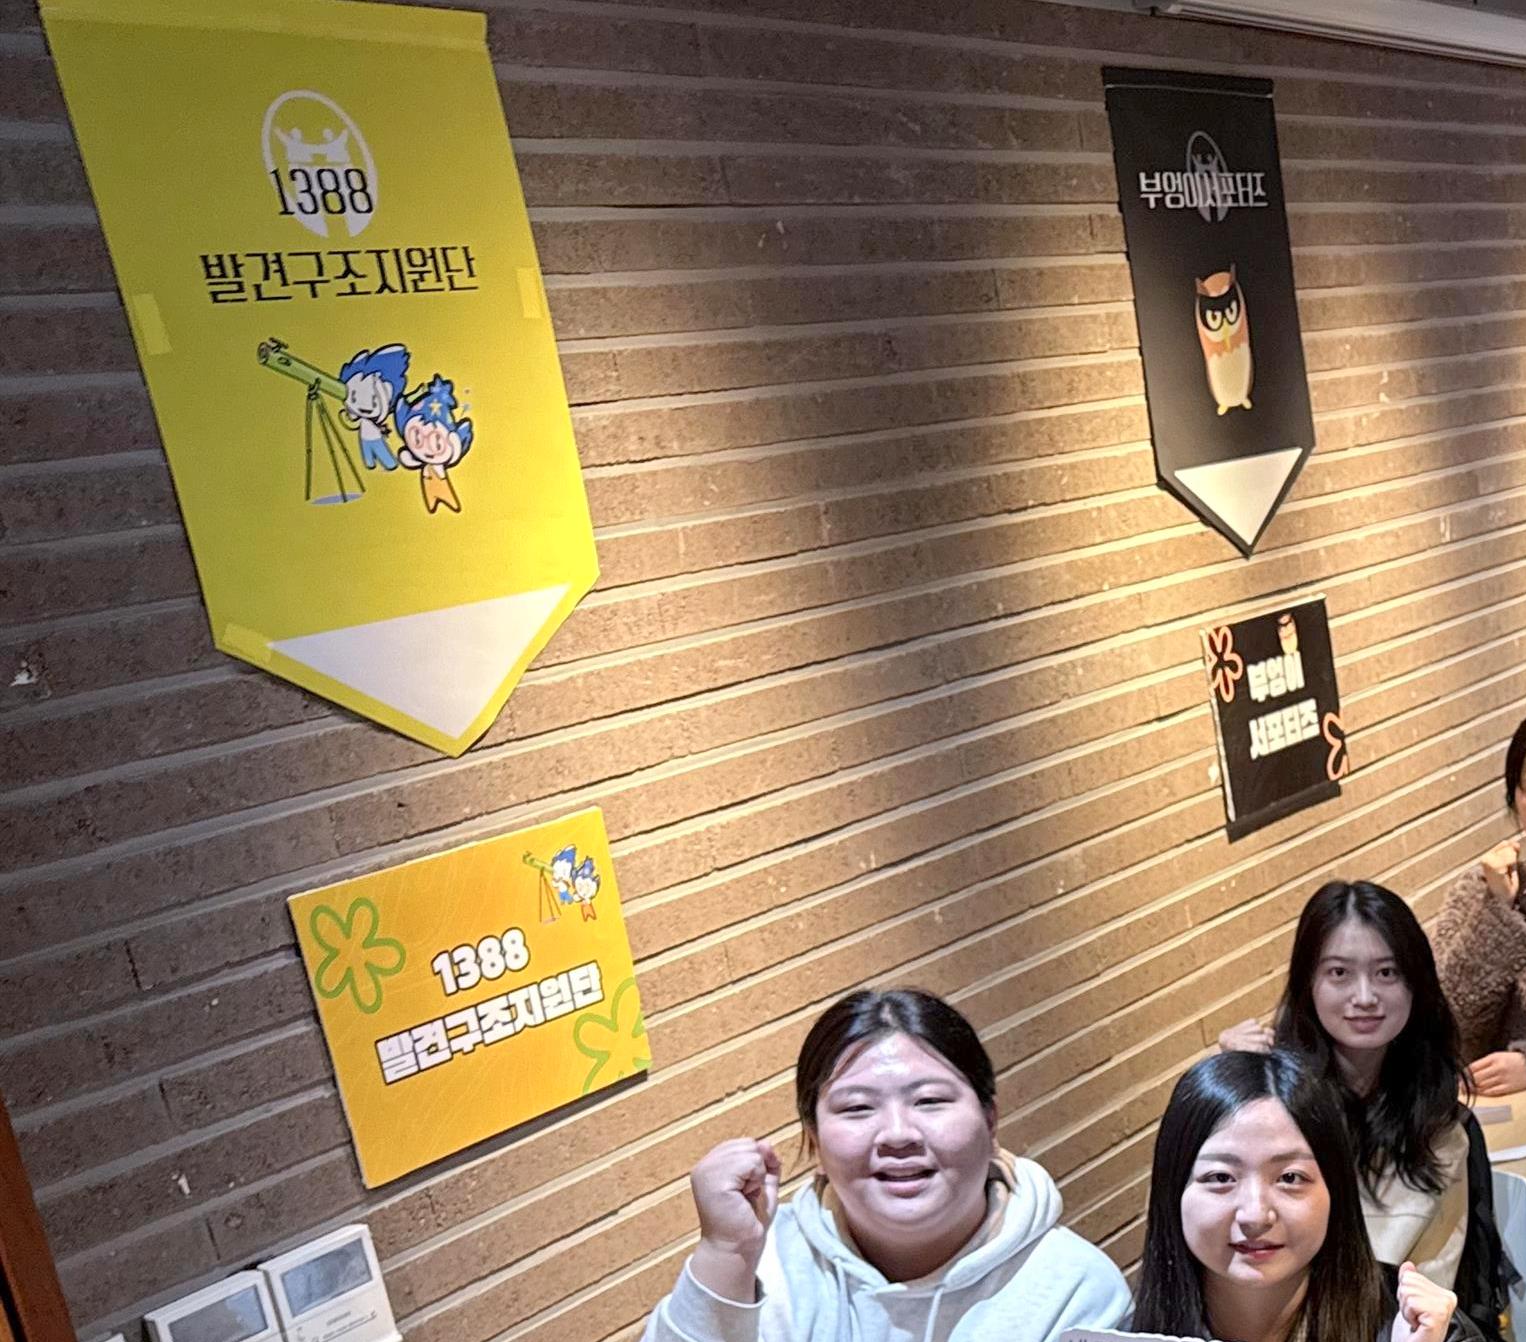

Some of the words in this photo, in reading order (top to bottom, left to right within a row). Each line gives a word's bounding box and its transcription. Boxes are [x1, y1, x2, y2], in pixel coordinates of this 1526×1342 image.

[269, 167, 375, 215] 1388
[199, 245, 480, 303] 발견구조지원단
[431, 927, 532, 996] 1388
[374, 960, 605, 1085] 발견구조지원단
